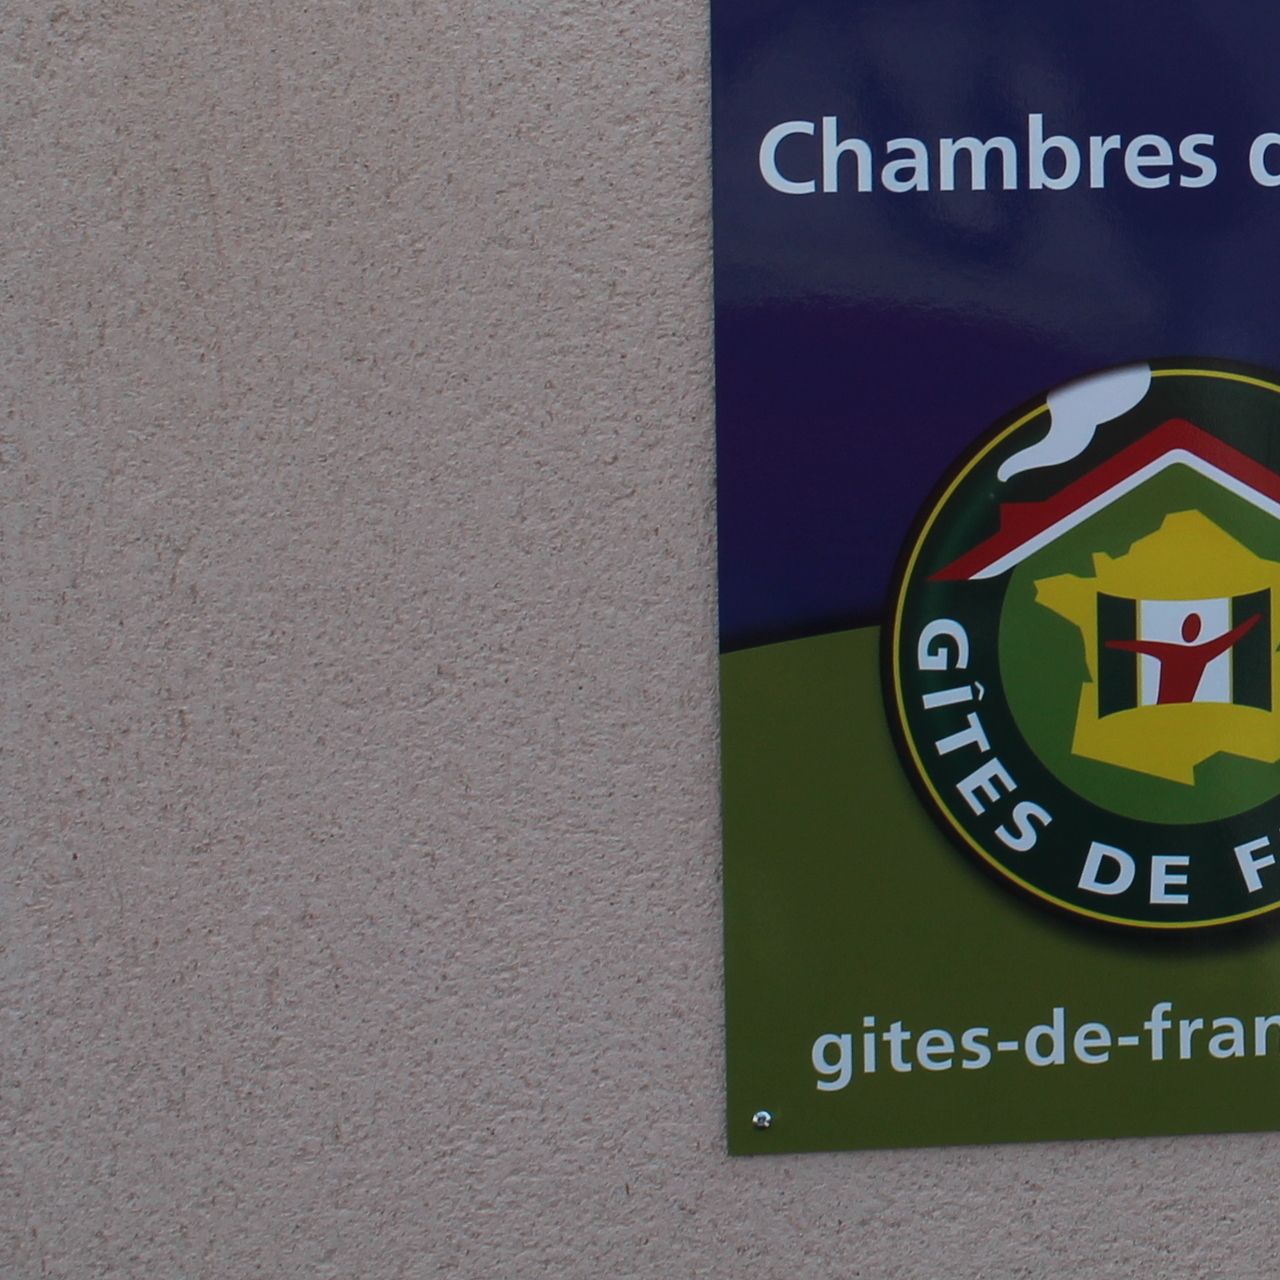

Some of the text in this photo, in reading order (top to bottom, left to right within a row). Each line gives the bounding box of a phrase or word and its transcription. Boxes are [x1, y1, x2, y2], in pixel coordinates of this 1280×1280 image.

[758, 113, 1218, 194] Chambres
[917, 617, 1053, 853] GÎTES
[1077, 841, 1190, 904] DE
